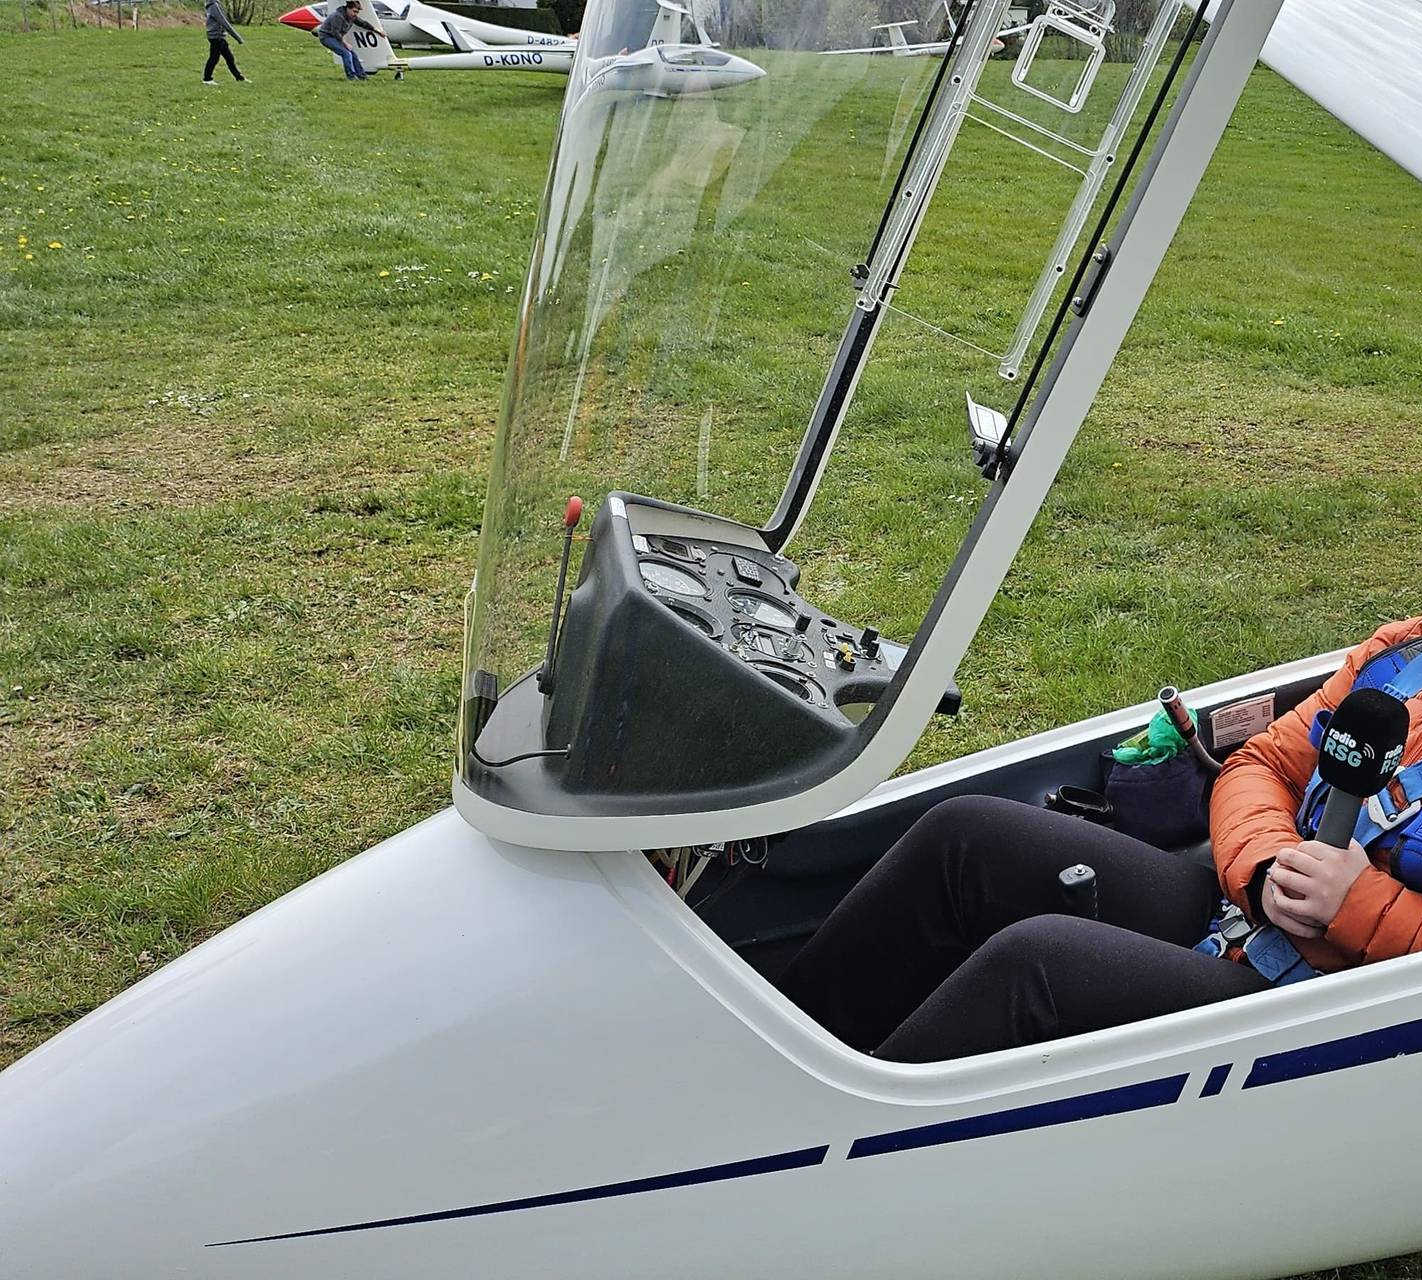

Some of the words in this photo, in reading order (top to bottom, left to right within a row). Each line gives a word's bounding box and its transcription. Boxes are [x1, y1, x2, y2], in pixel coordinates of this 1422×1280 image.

[353, 31, 378, 48] NO
[1328, 728, 1357, 748] radio
[1324, 736, 1362, 767] RSG
